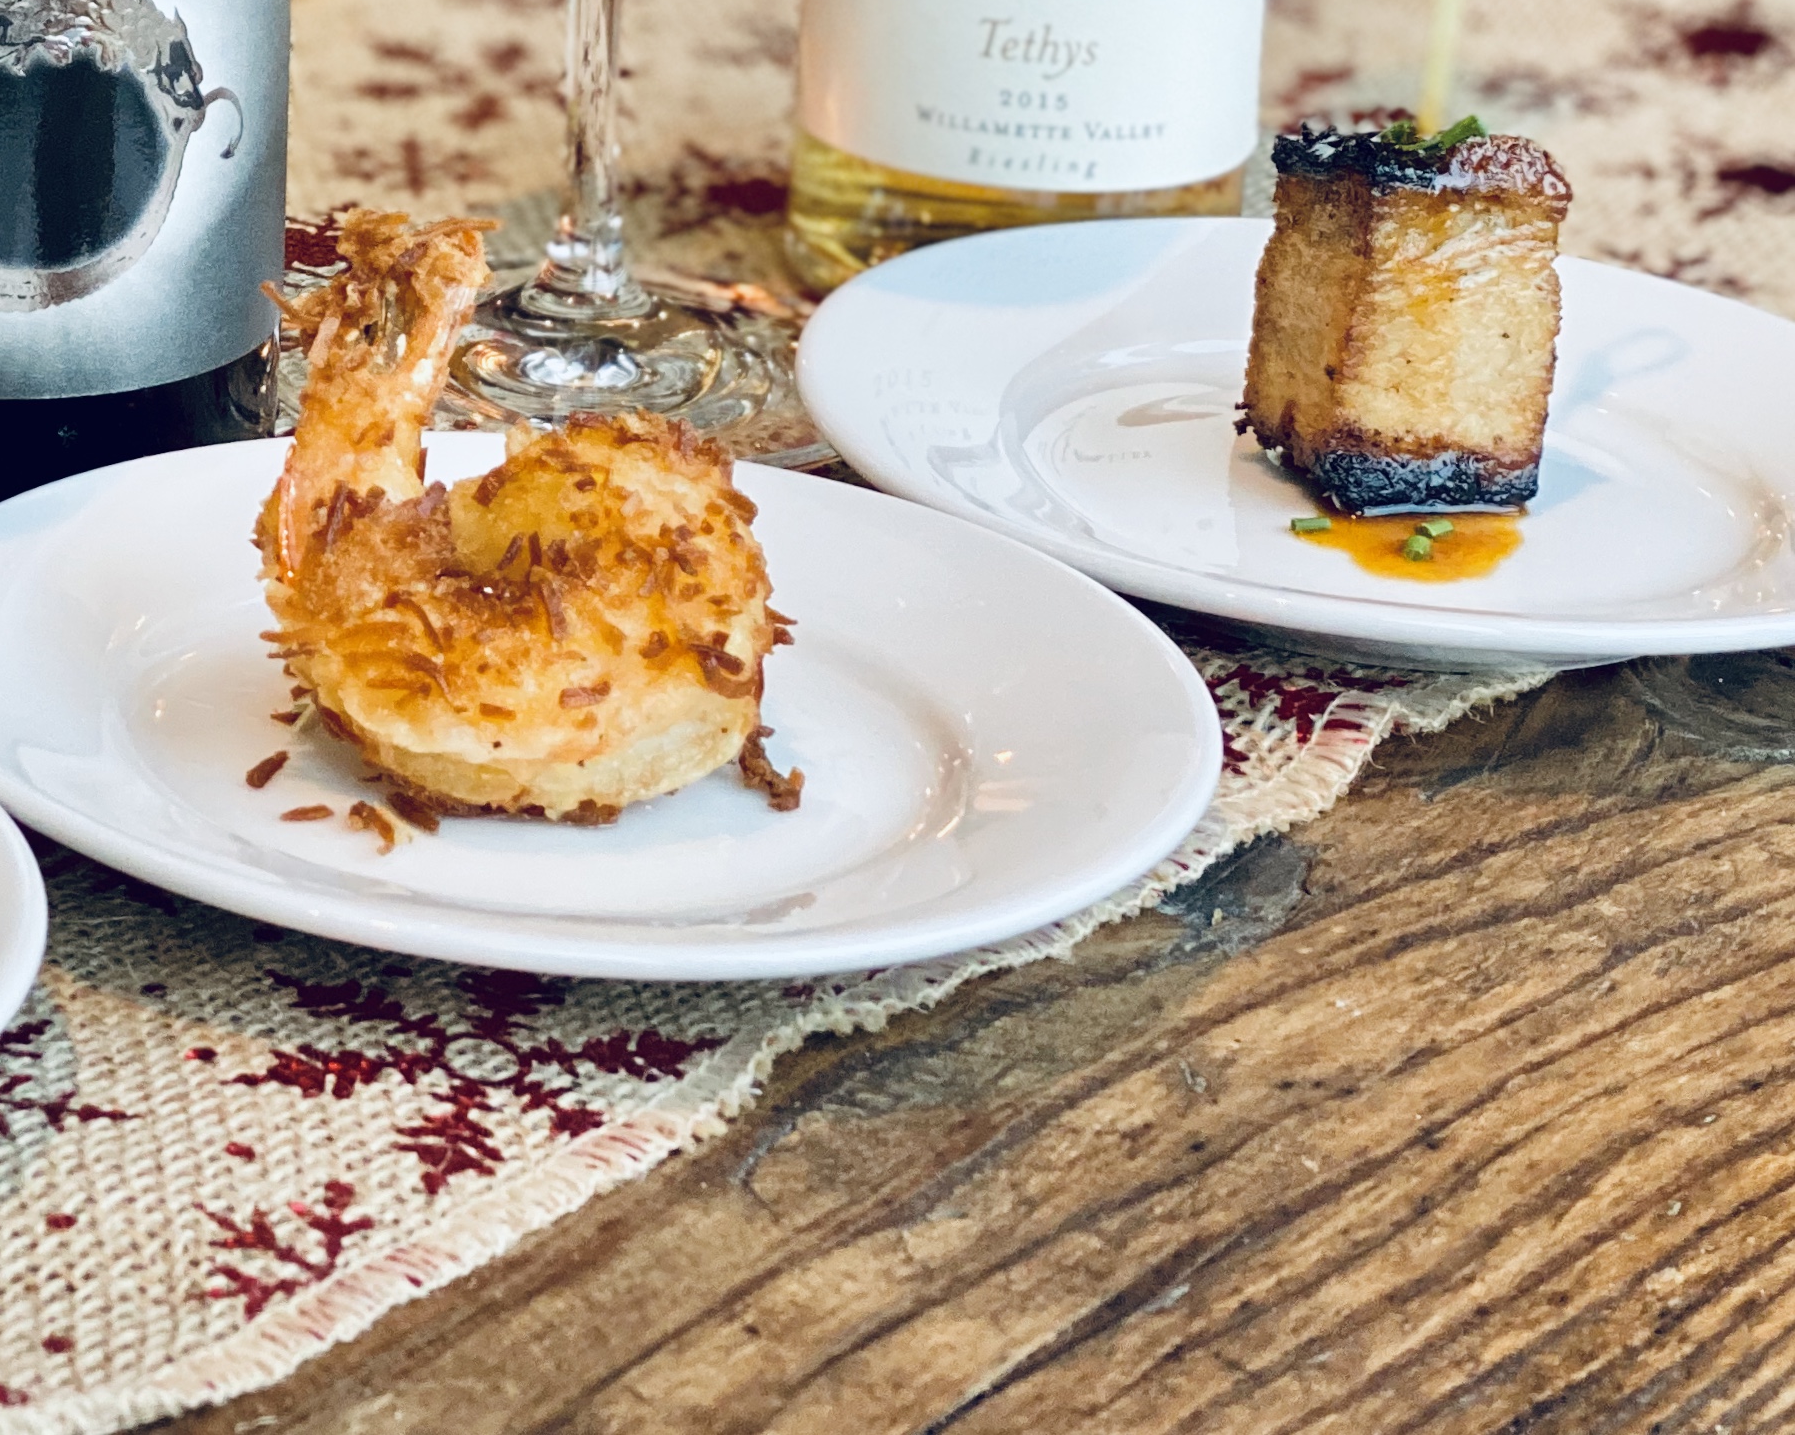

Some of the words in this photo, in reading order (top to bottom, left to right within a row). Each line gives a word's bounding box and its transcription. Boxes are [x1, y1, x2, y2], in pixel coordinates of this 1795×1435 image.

[979, 17, 1099, 81] Tethys
[1000, 89, 1068, 112] 2015
[915, 104, 1072, 141] WILLAMETTE
[1082, 120, 1167, 141] VALLEY
[968, 147, 1098, 180] Riesling
